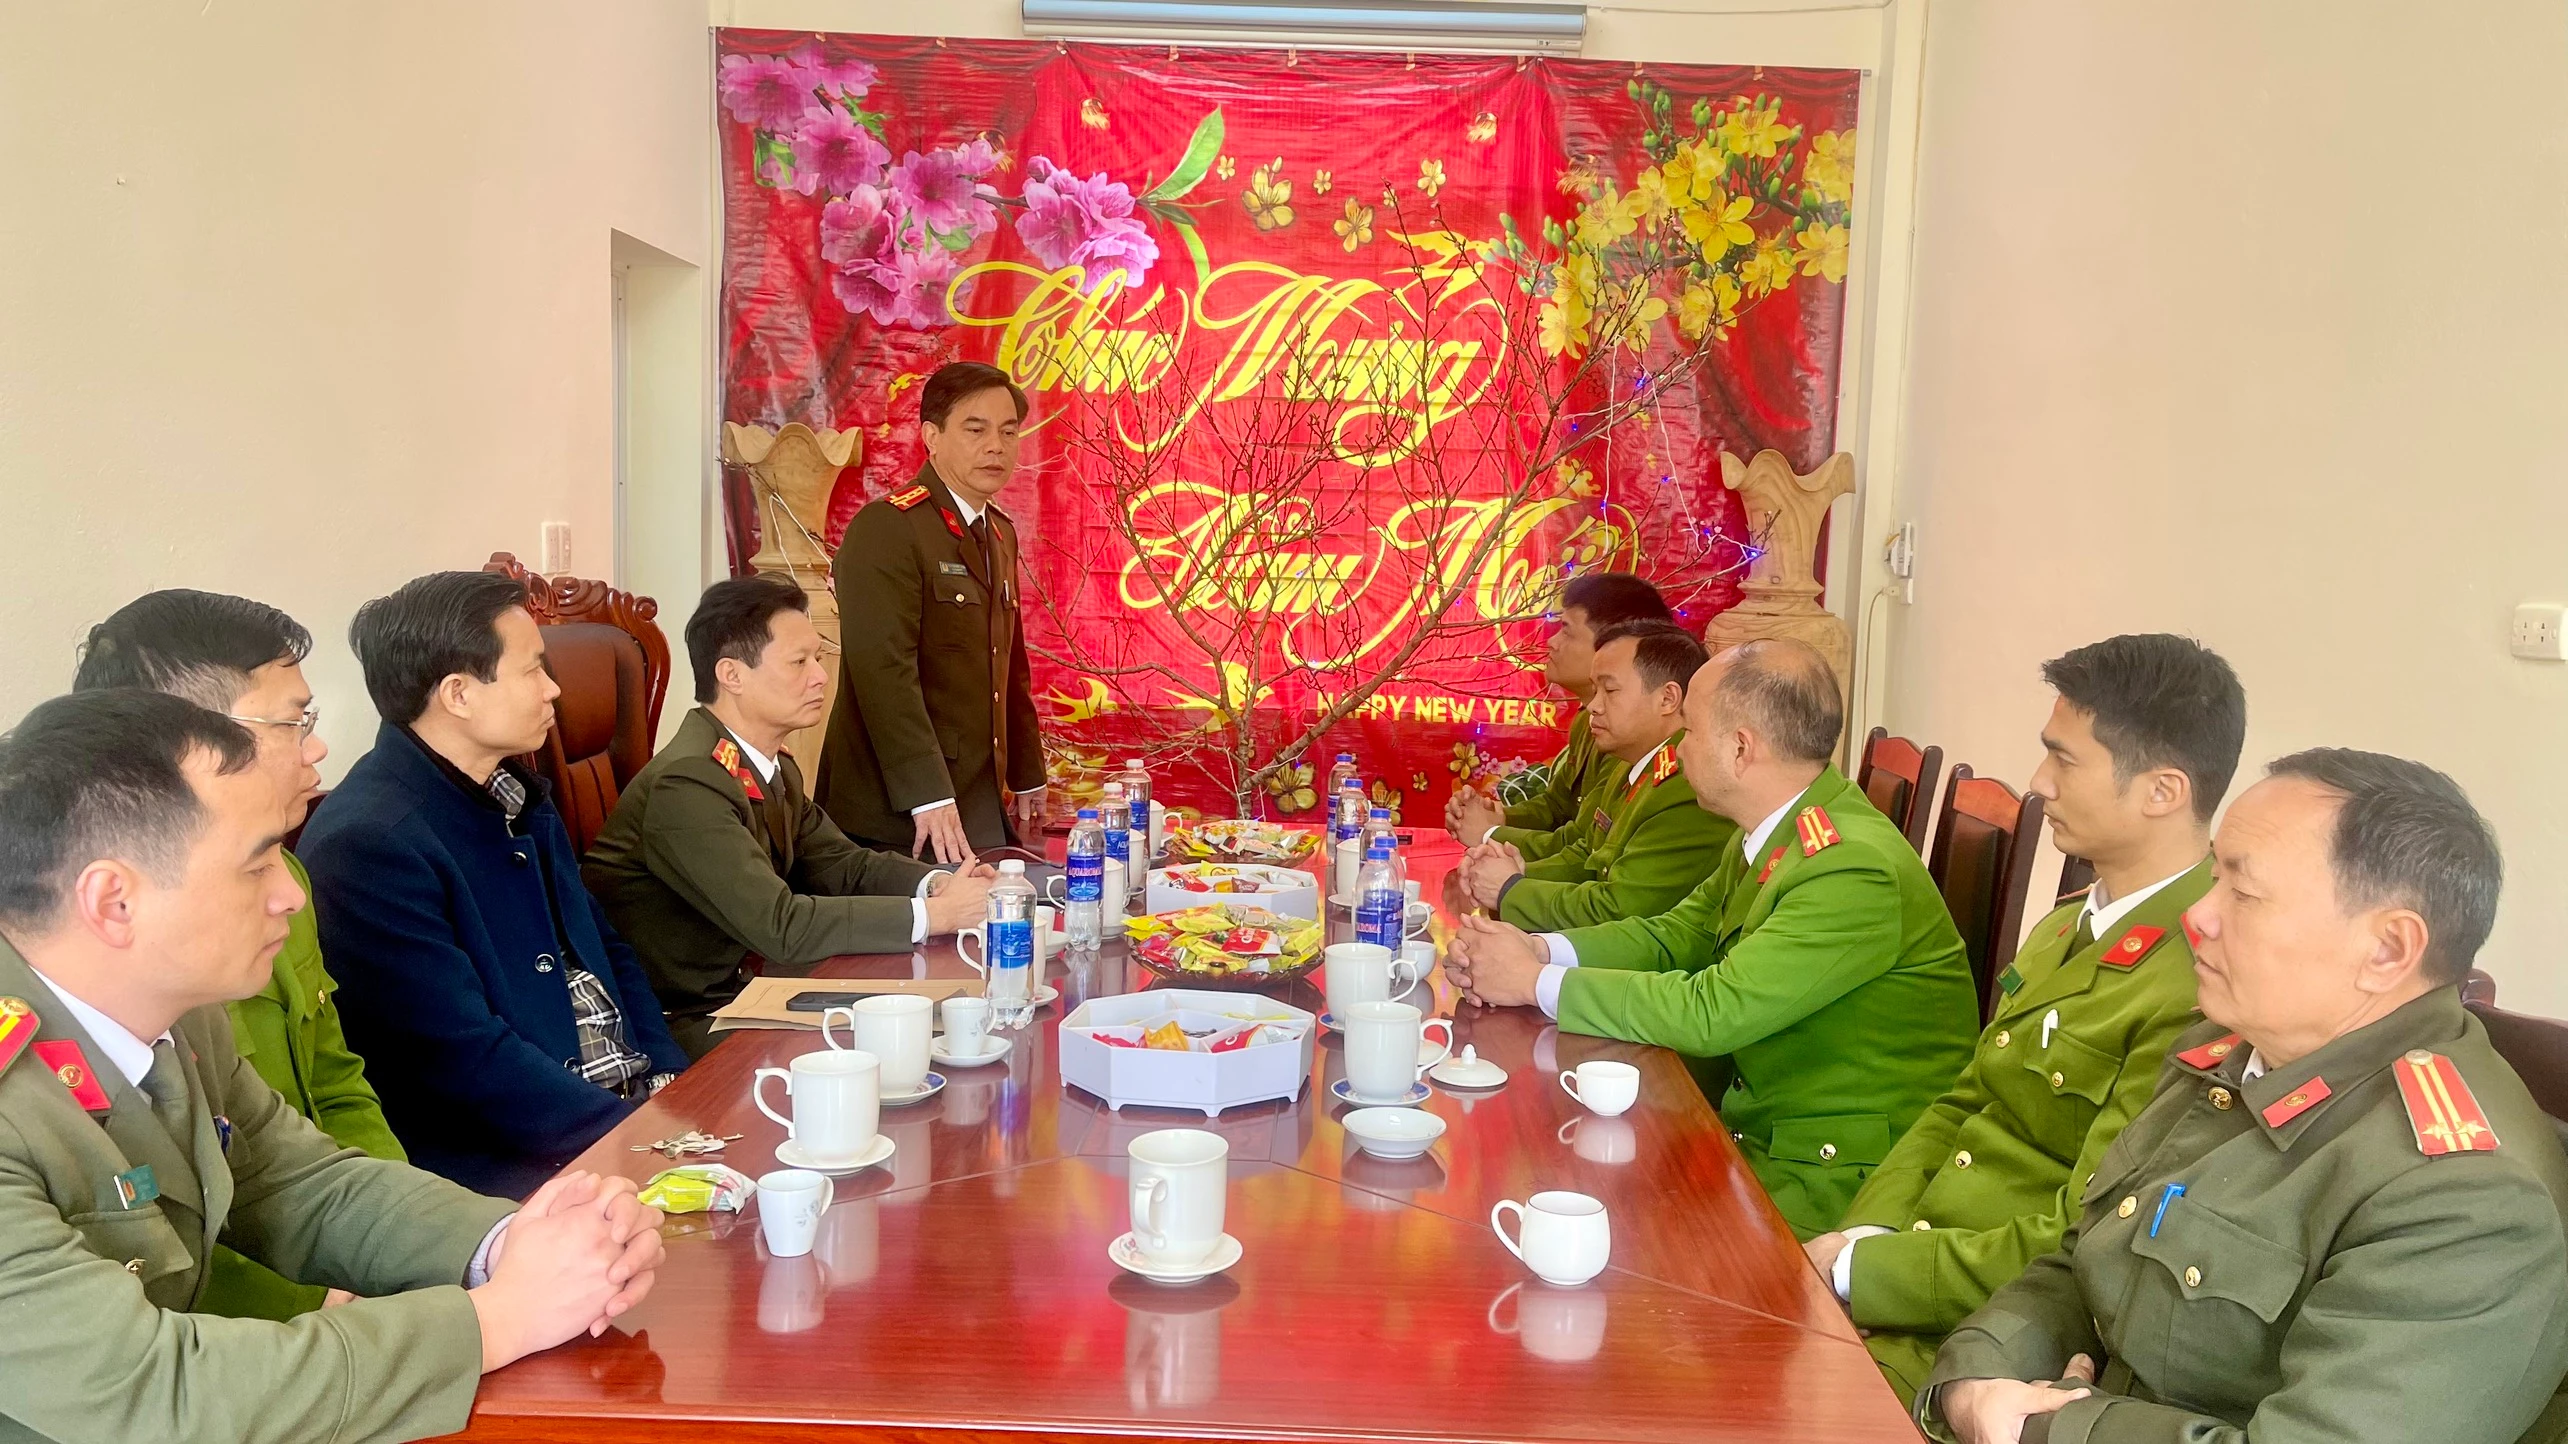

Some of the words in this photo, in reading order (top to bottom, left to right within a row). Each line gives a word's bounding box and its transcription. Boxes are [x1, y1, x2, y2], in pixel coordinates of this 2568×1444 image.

[945, 261, 1190, 440] Chúc
[1115, 260, 1509, 467] Mừng
[1119, 481, 1387, 616] Năm
[1317, 691, 1408, 721] HPPY
[1414, 695, 1476, 724] NEW
[1483, 697, 1557, 727] YEAR
